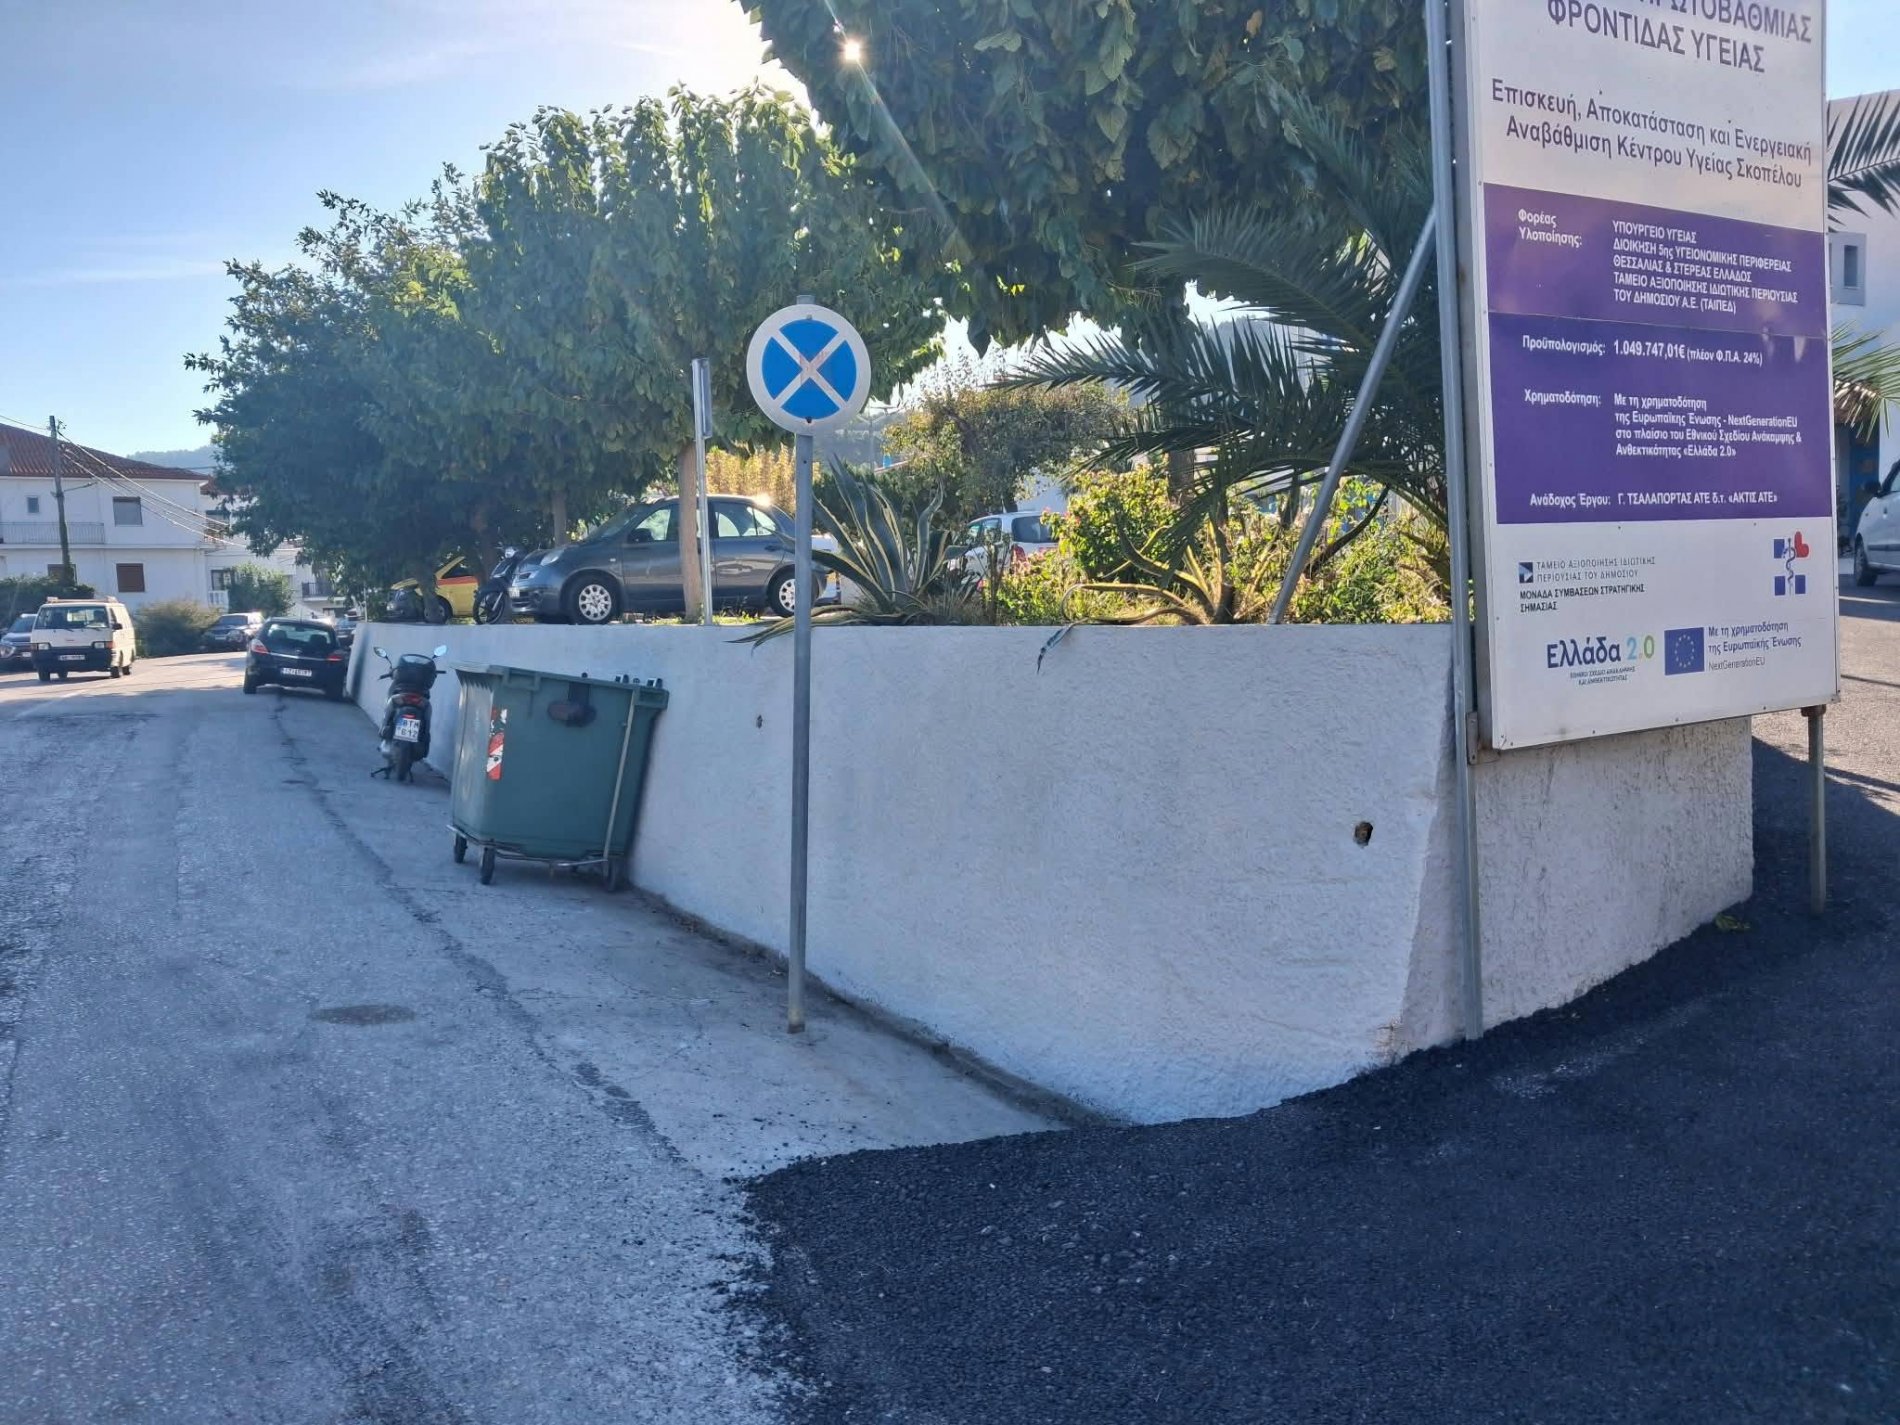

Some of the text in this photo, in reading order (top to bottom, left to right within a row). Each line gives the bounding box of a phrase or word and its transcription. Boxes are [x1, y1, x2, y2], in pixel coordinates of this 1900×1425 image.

[1640, 0, 1811, 43] ΟΒΑΘΜΙΑΣ
[1548, 0, 1764, 72] ΦΡΟΝΤΙΔΑΣ ΥΓΕΙΑΣ
[1492, 78, 1811, 166] Επισκευή, Αποκατάσταση και Ενεργειακή
[1506, 115, 1802, 188] Αναβάθμιση Κέντρου Υγείας Σκοπέλου
[1518, 209, 1557, 228] Φορέας
[1519, 226, 1582, 248] Υλοποίησης:
[1612, 220, 1697, 244] ΥΠΟΥΡΓΕΙΟ ΥΓΕΙΑΣ
[1613, 238, 1657, 255] ΔΙΟΙΚΗΣΗ
[1675, 245, 1738, 265] ΥΓΕΙΟΝΟΜΙΚΗΣ
[1739, 254, 1792, 272] ΠΕΡΙΦΕΡΕΙΑΣ
[1613, 255, 1752, 283] ΘΕΣΣΑΛΙΑΣ & ΣΤΕΡΕΑΣ ΕΛΛΑΔΟΣ
[1613, 272, 1799, 304] ΤΑΜΕΙΟ ΑΞΙΟΠΟΙΗΣΗΣ ΙΔΙΩΤΙΚΗΣ ΠΕΡΙΟΥΣΙΑΣ
[1614, 288, 1737, 315] ΤΟΥ ΔΗΜΟΣΙΟΥ Α.Ε. (ΤΑΙΠΕΔ)
[1522, 335, 1763, 367] Προϋπολογισμός: 1.049.747,01€ (πλέον Φ.Π.Α. 24%)
[1524, 389, 1707, 412] Χρηματοδότηση: Με τη χρηματοδότηση
[1615, 412, 1631, 425] της
[1687, 413, 1722, 428] Ένωσης
[1727, 414, 1798, 428] NextGenerationEU
[1615, 430, 1632, 440] στο
[1634, 428, 1668, 441] πλαίσιο
[1669, 430, 1684, 441] του
[1718, 429, 1751, 444] Σχεδίου
[1795, 432, 1802, 443] &
[1615, 443, 1682, 459] Ανθεκτικότητας
[1530, 493, 1576, 508] Ανάδοχος
[1577, 493, 1611, 508] Έργου:
[1617, 493, 1626, 505] Γ.
[1627, 492, 1693, 505] ΤΣΑΛΑΠΟΡΤΑΣ
[1693, 492, 1711, 505] ΑΤΕ
[1537, 560, 1566, 570] ΤΑΜΕΙΟ
[1584, 571, 1598, 580] ΤΟΥ
[1600, 568, 1639, 579] ΔΗΜΟΣΙΟΥ
[1520, 583, 1645, 600] ΜΟΝΑΔΑ ΣΥΜΒΑΣΕΩΝ ΣΤΡΑΤΗΓΙΚΗΣ
[1520, 601, 1558, 613] ΣΗΜΑΣΙΑΣ
[1709, 621, 1789, 638] Με τη χρηματοδότηση
[1547, 635, 1655, 669] Ελλάδα 2.0
[1708, 644, 1721, 656] της
[1771, 636, 1802, 648] Ένωσης
